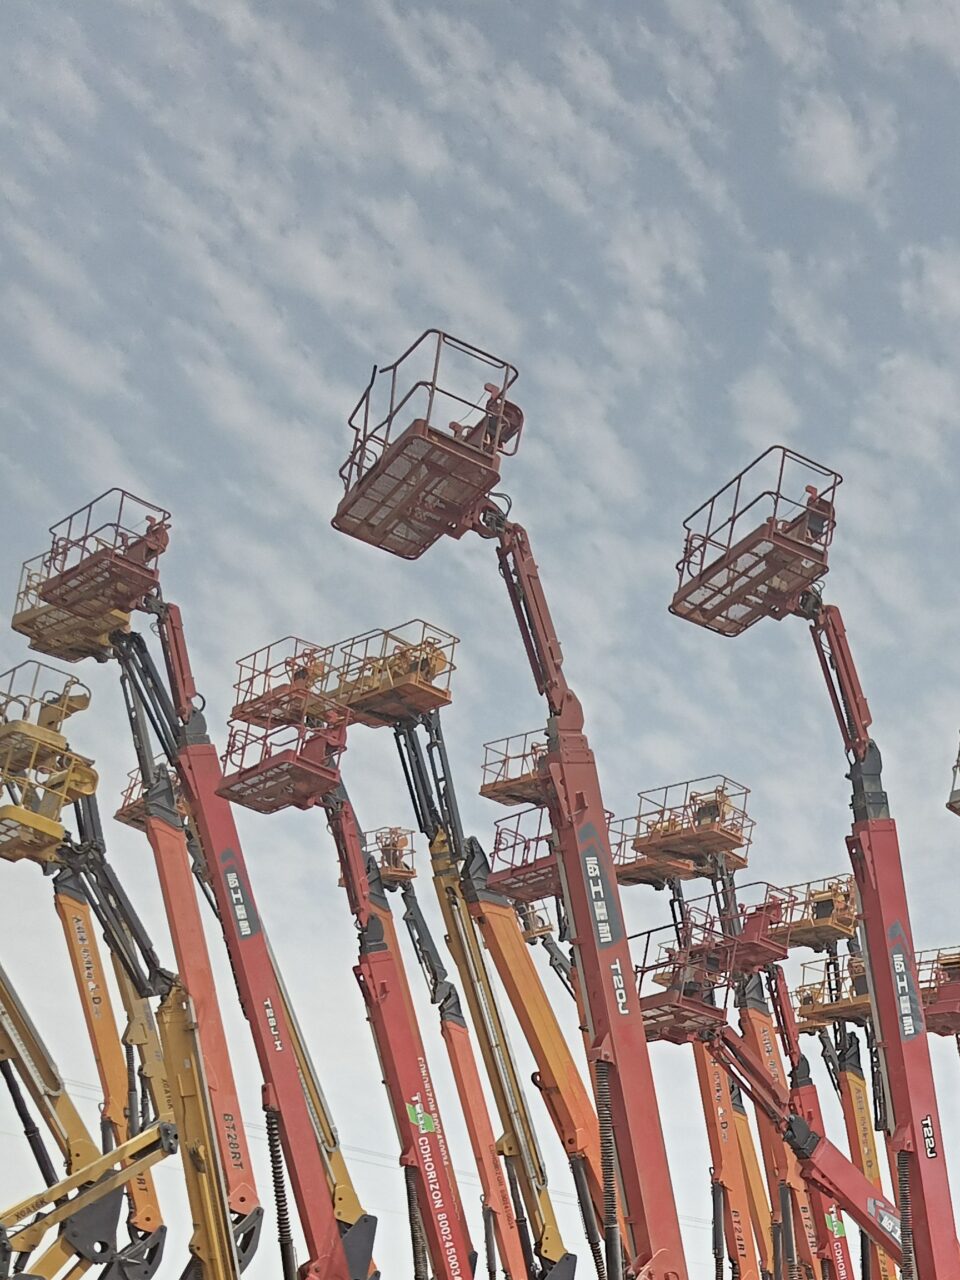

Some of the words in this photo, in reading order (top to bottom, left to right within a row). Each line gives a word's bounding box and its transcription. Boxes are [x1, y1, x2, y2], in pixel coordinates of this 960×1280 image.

[610, 958, 629, 1015] T20J
[223, 1113, 244, 1170] BT28RT
[921, 1115, 937, 1159] T22J
[418, 1137, 443, 1208] CDHORIZON
